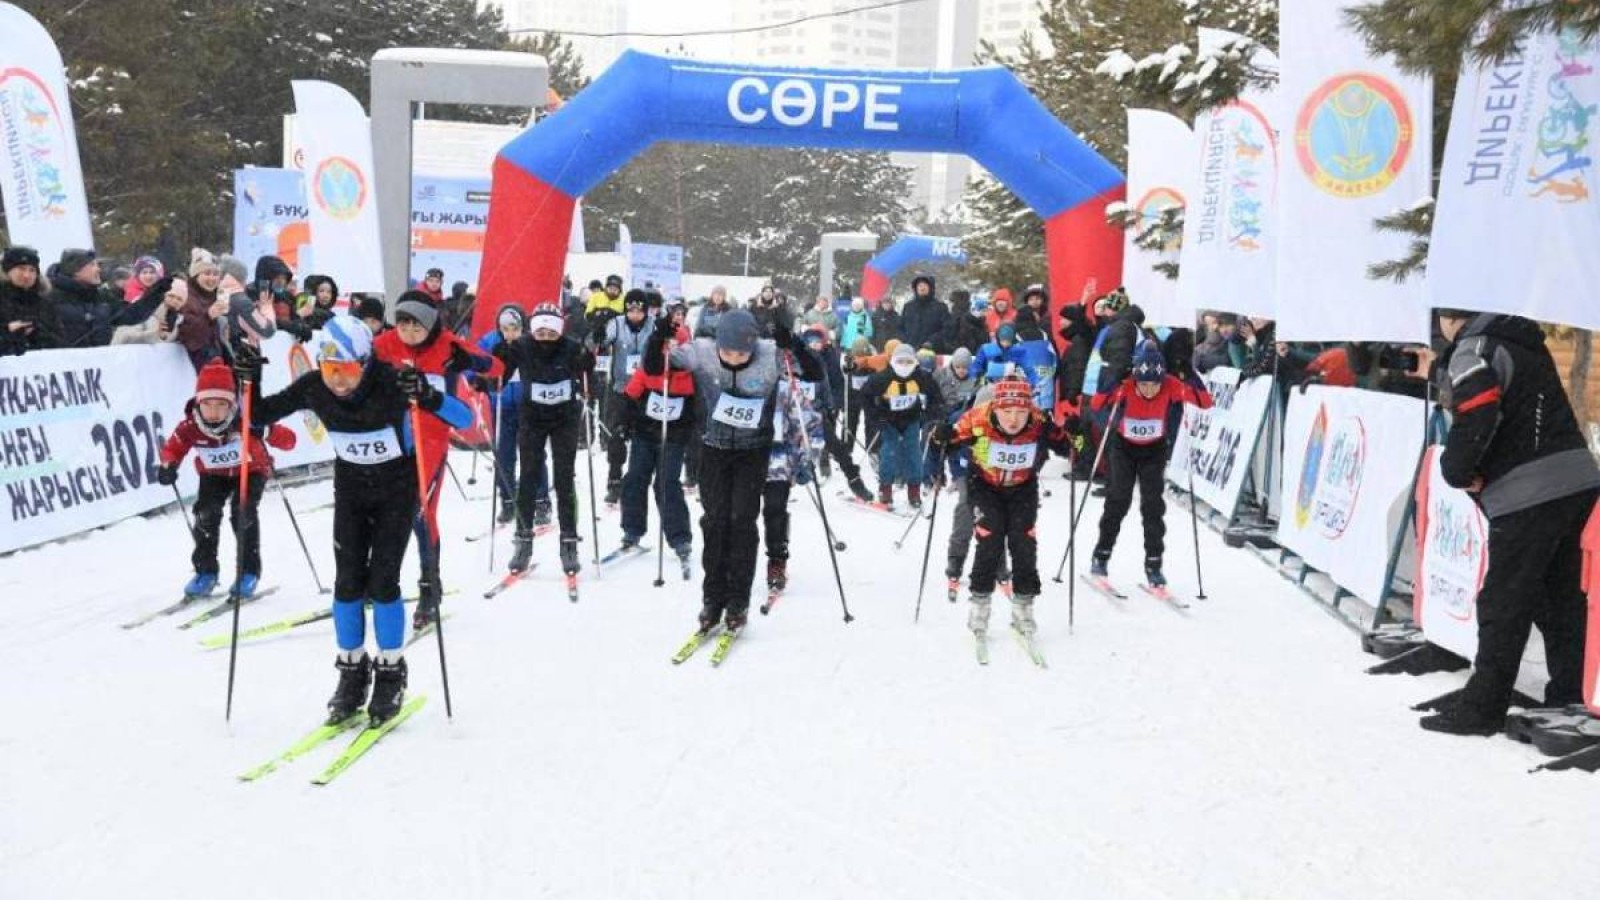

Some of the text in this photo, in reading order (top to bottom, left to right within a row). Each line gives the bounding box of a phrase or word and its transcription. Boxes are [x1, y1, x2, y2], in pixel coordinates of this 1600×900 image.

[727, 76, 902, 132] СӨРЕ
[723, 406, 755, 421] 458
[1130, 425, 1155, 436] 403
[346, 440, 388, 457] 478
[998, 451, 1027, 465] 385
